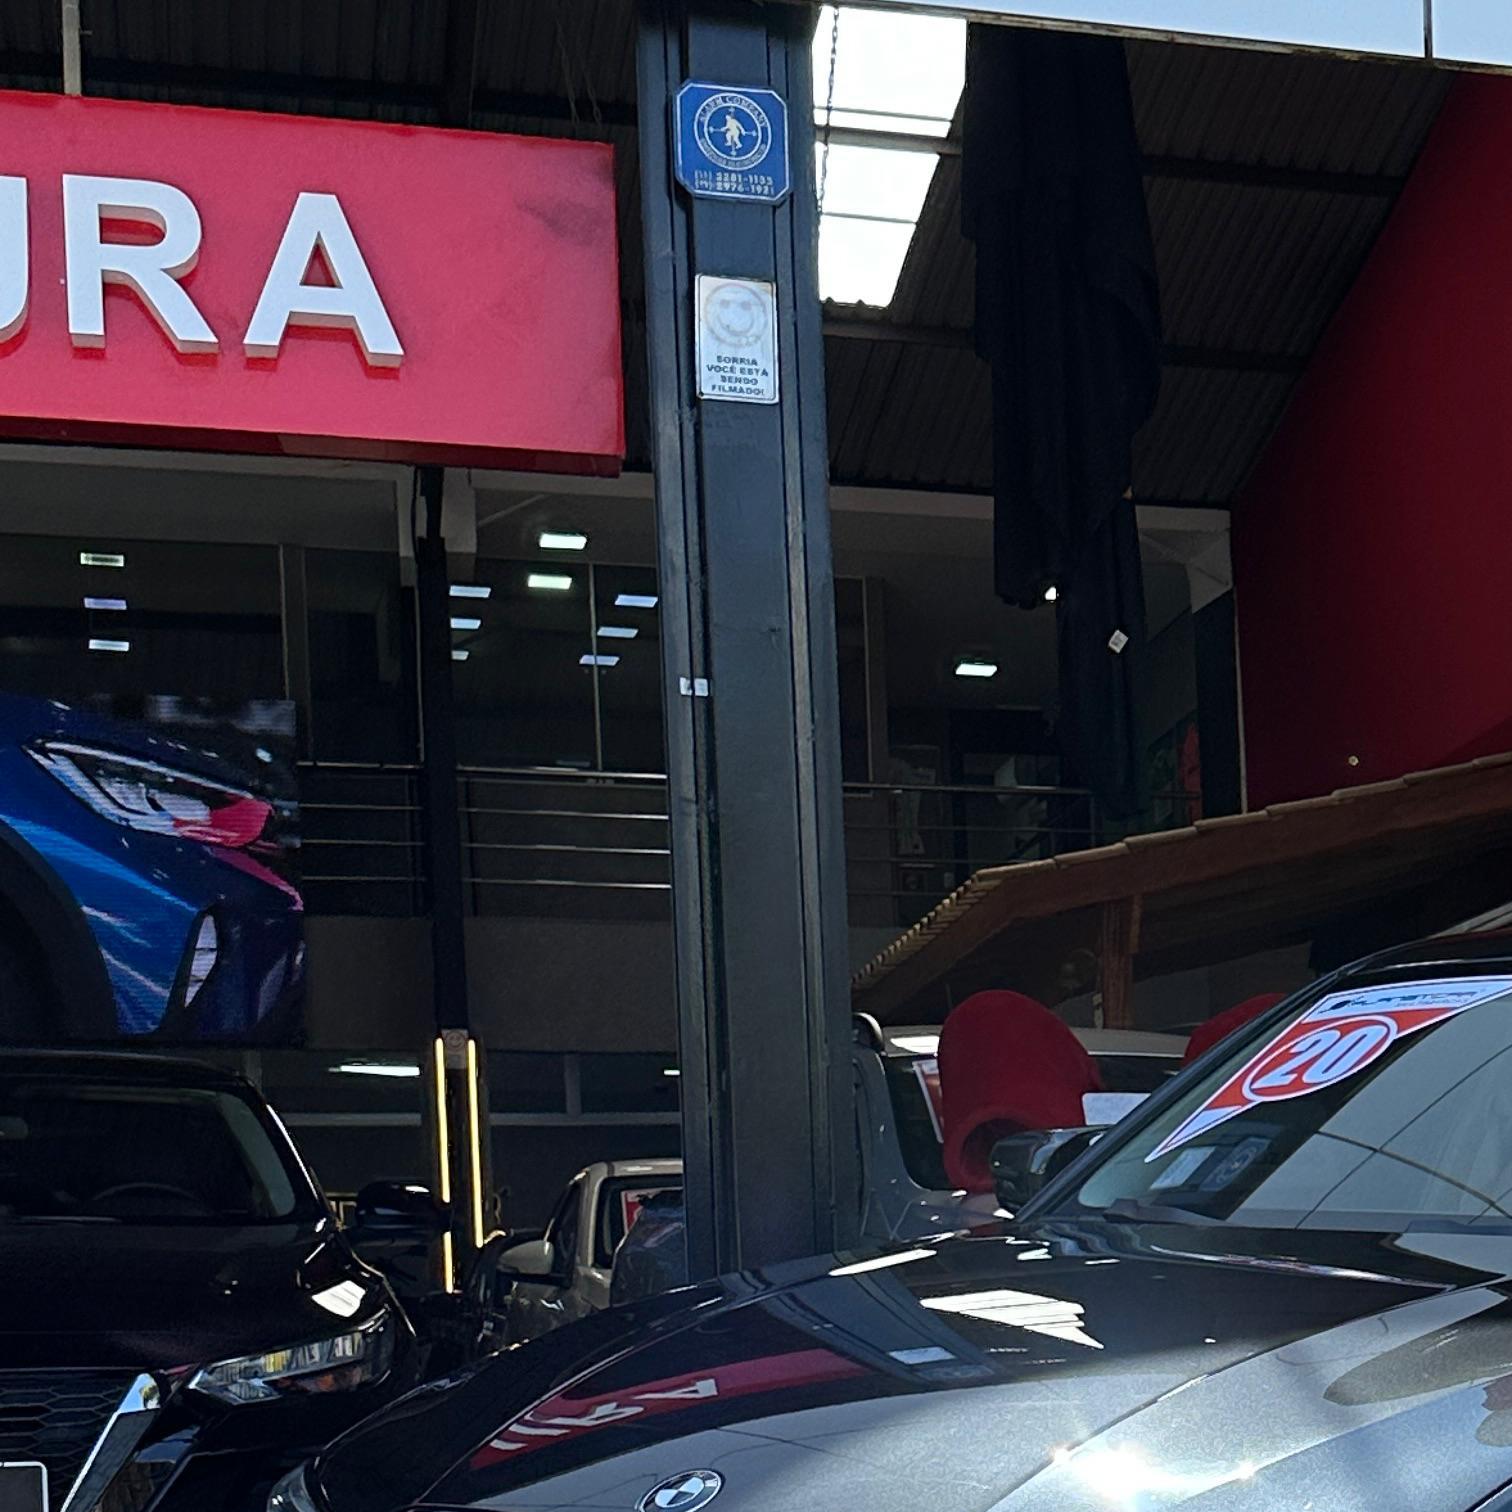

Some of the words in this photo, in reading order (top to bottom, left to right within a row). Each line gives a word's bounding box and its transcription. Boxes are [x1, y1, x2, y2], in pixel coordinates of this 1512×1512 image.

[0, 173, 404, 366] RA
[716, 355, 758, 366] SORRIA
[720, 375, 759, 386] SENDO
[711, 384, 764, 396] FILMADO!
[1250, 1024, 1391, 1090] 20
